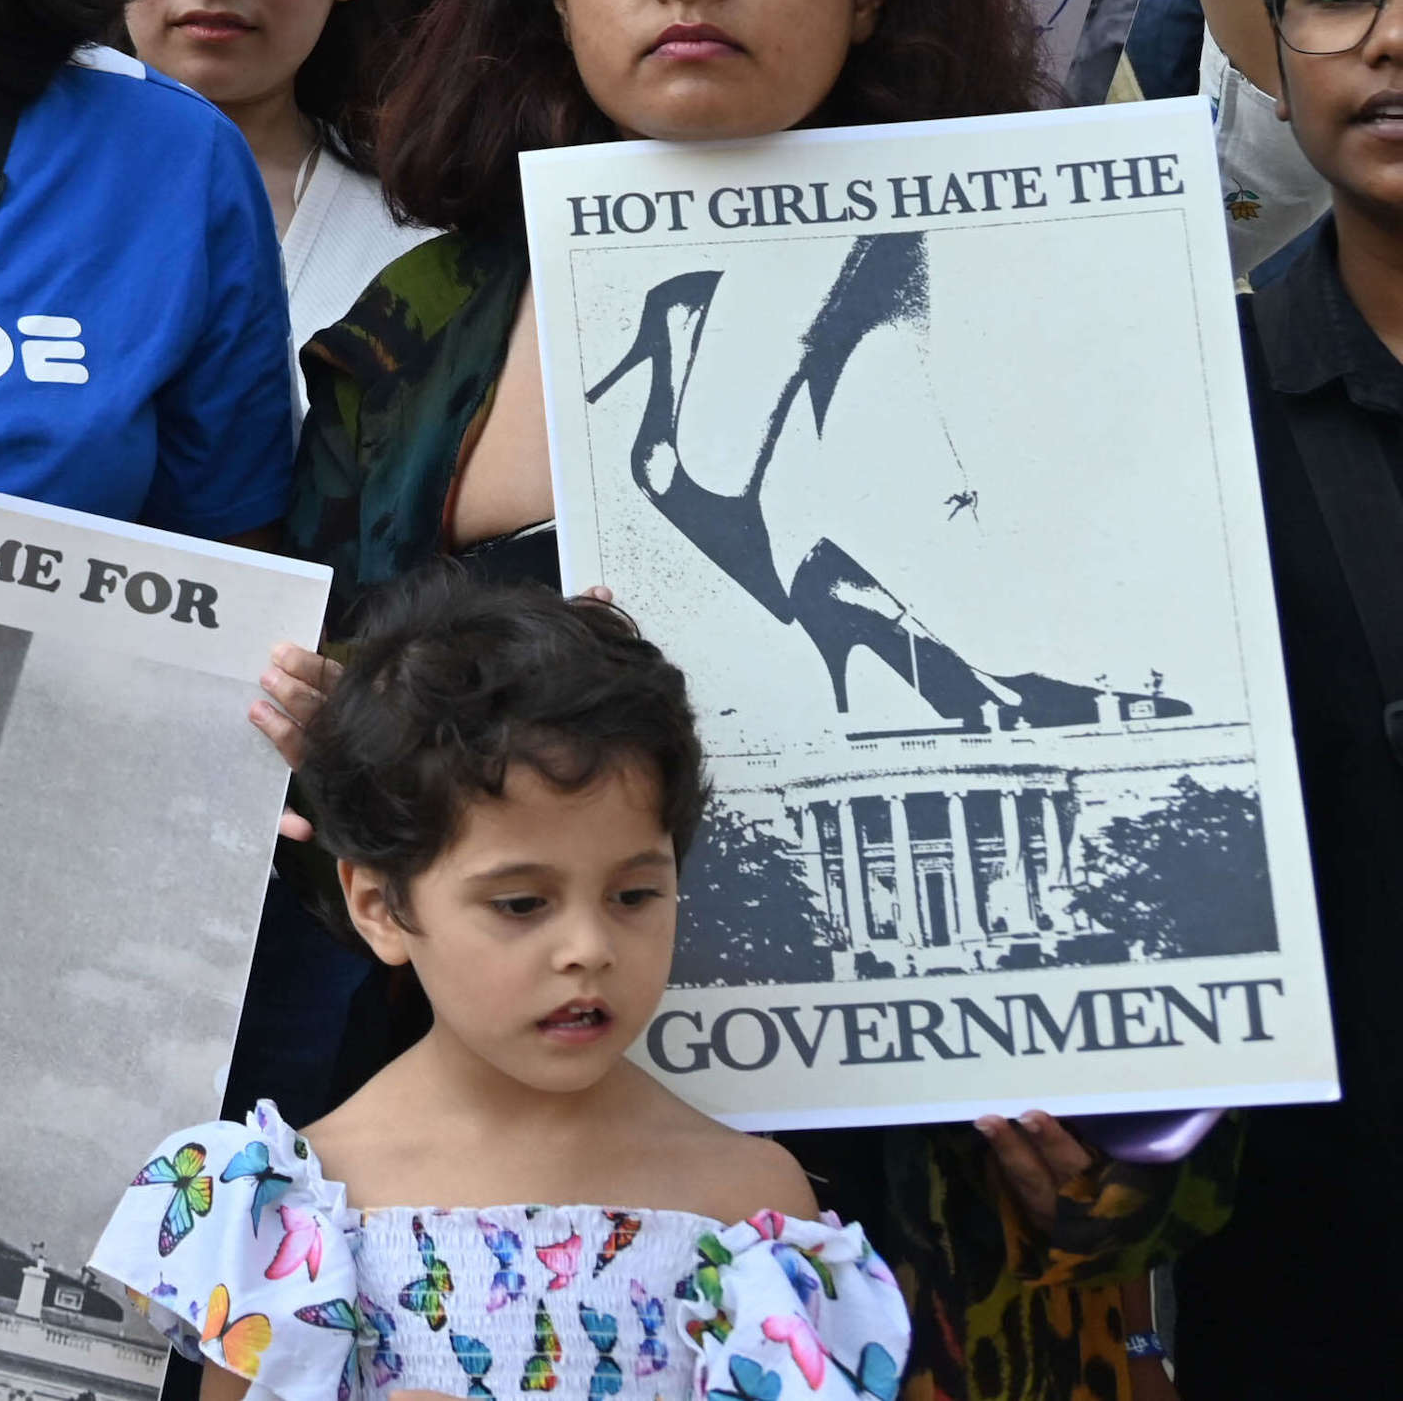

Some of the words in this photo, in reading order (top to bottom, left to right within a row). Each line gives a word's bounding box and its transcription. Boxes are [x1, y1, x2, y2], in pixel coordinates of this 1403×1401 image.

[569, 189, 694, 237] HOT
[708, 179, 878, 228] GIRLS
[887, 166, 1048, 219] HATE
[1056, 154, 1185, 200] THE
[78, 557, 221, 630] FOR
[646, 978, 1285, 1075] GOVERNMENT
